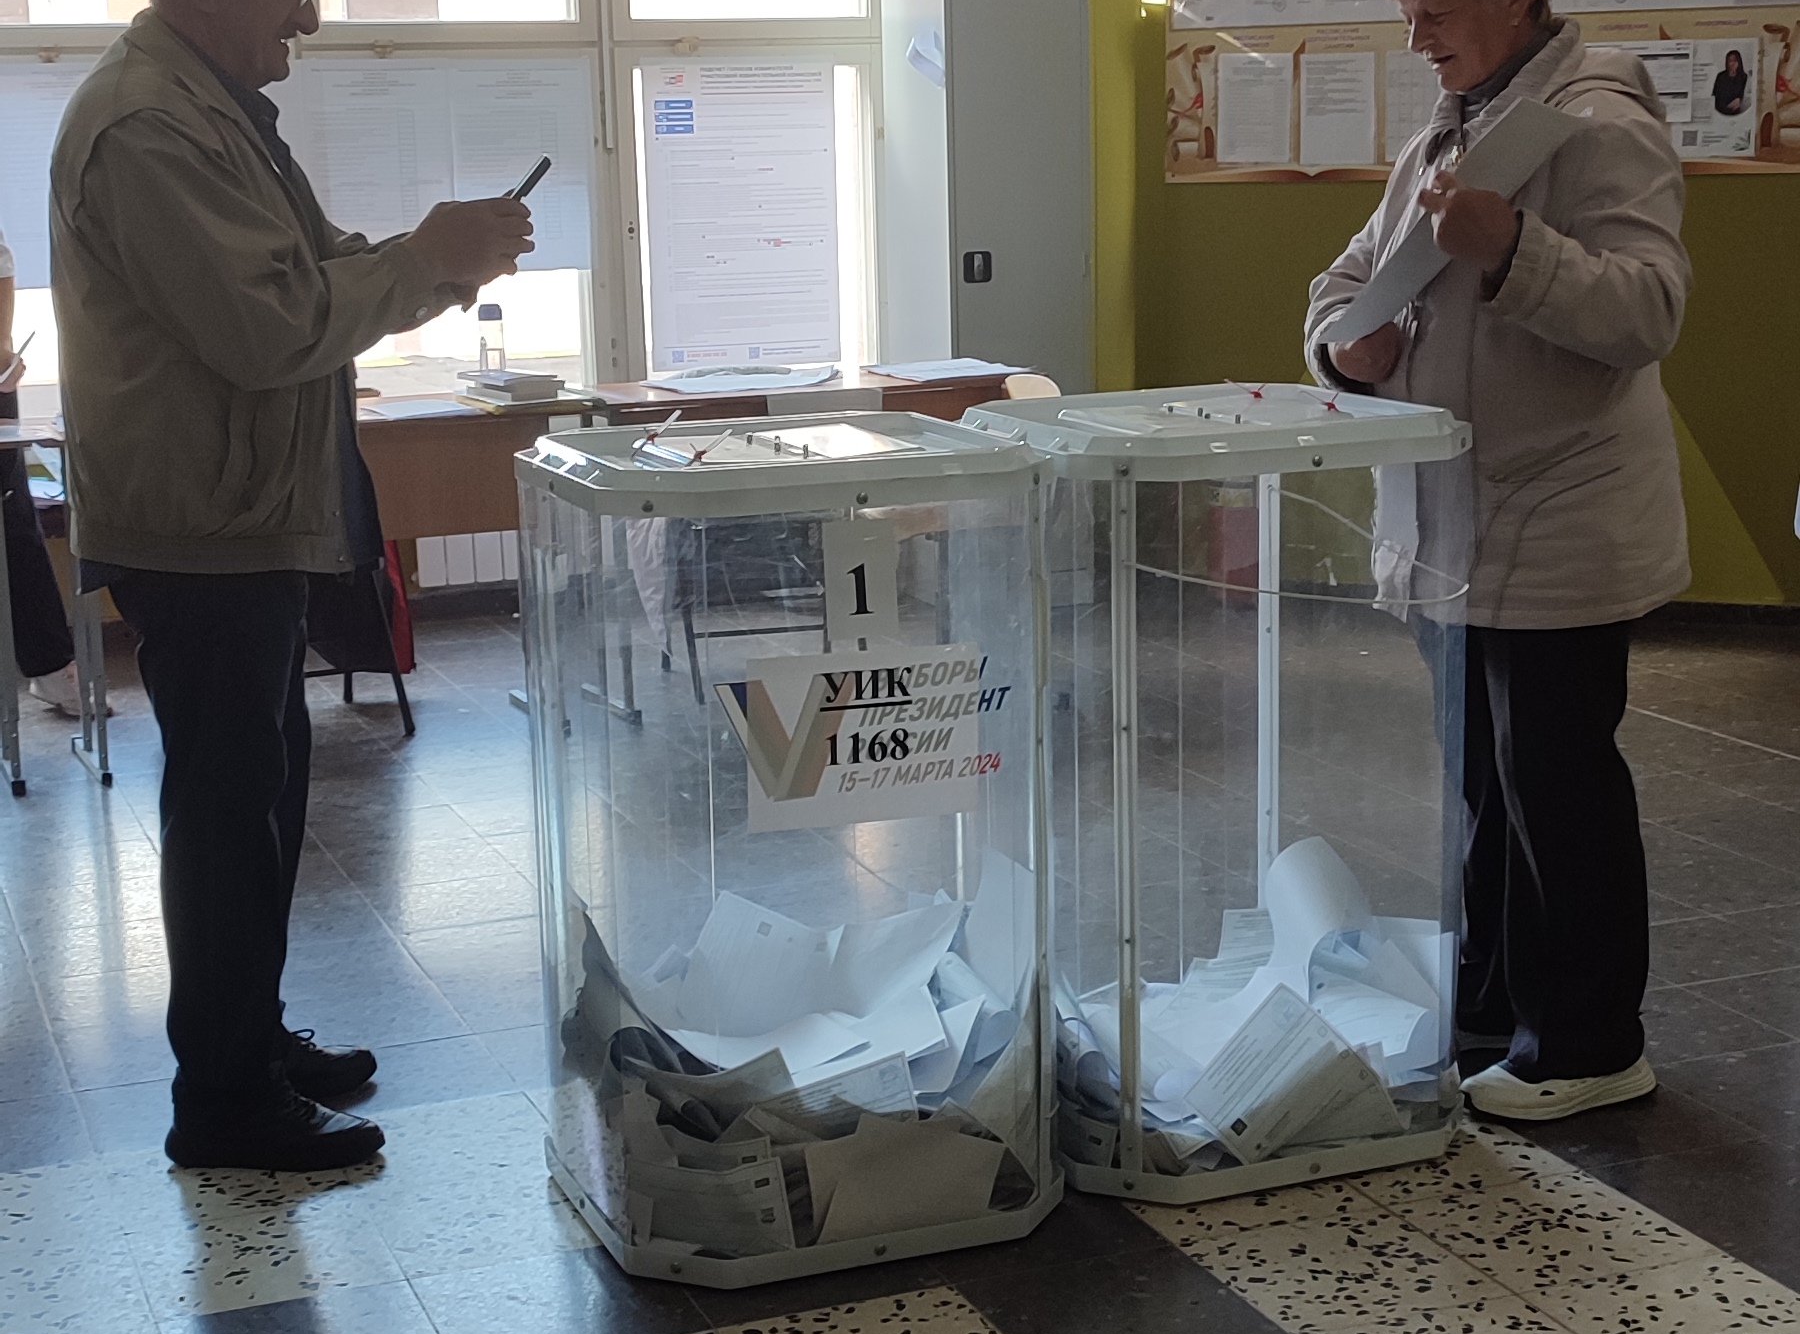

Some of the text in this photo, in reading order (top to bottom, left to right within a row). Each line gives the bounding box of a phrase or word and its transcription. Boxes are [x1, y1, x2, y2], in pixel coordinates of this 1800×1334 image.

[846, 562, 875, 616] 1
[821, 667, 912, 704] УИК
[826, 727, 910, 766] 1168
[891, 758, 955, 787] МАРТА
[957, 752, 1001, 778] 2024
